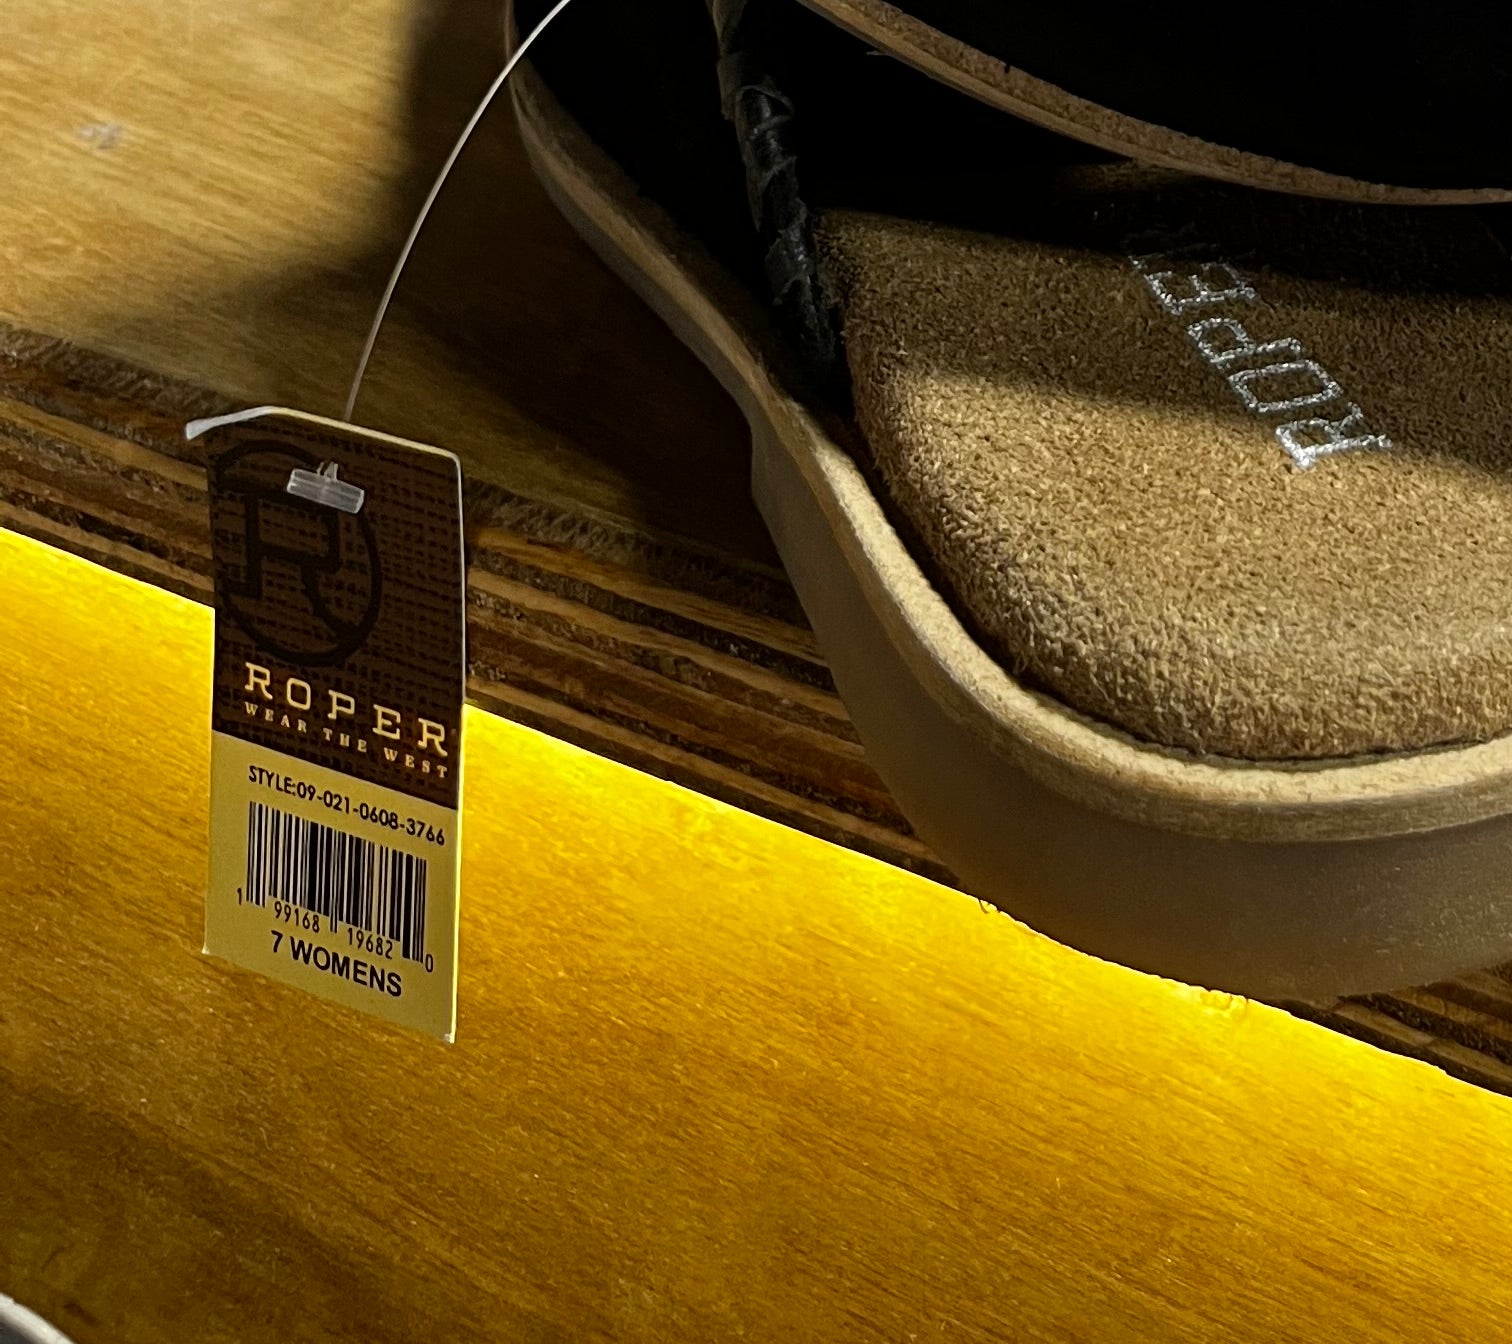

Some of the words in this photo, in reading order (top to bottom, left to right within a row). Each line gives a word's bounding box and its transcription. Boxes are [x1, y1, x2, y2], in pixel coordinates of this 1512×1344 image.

[244, 662, 448, 757] ROPER
[244, 701, 308, 734] WEAR
[322, 727, 368, 753] THE
[383, 746, 449, 779] WEST
[271, 929, 284, 953] 7
[289, 935, 402, 997] WOMENS
[273, 900, 321, 934] 99168
[347, 926, 393, 960] 19682
